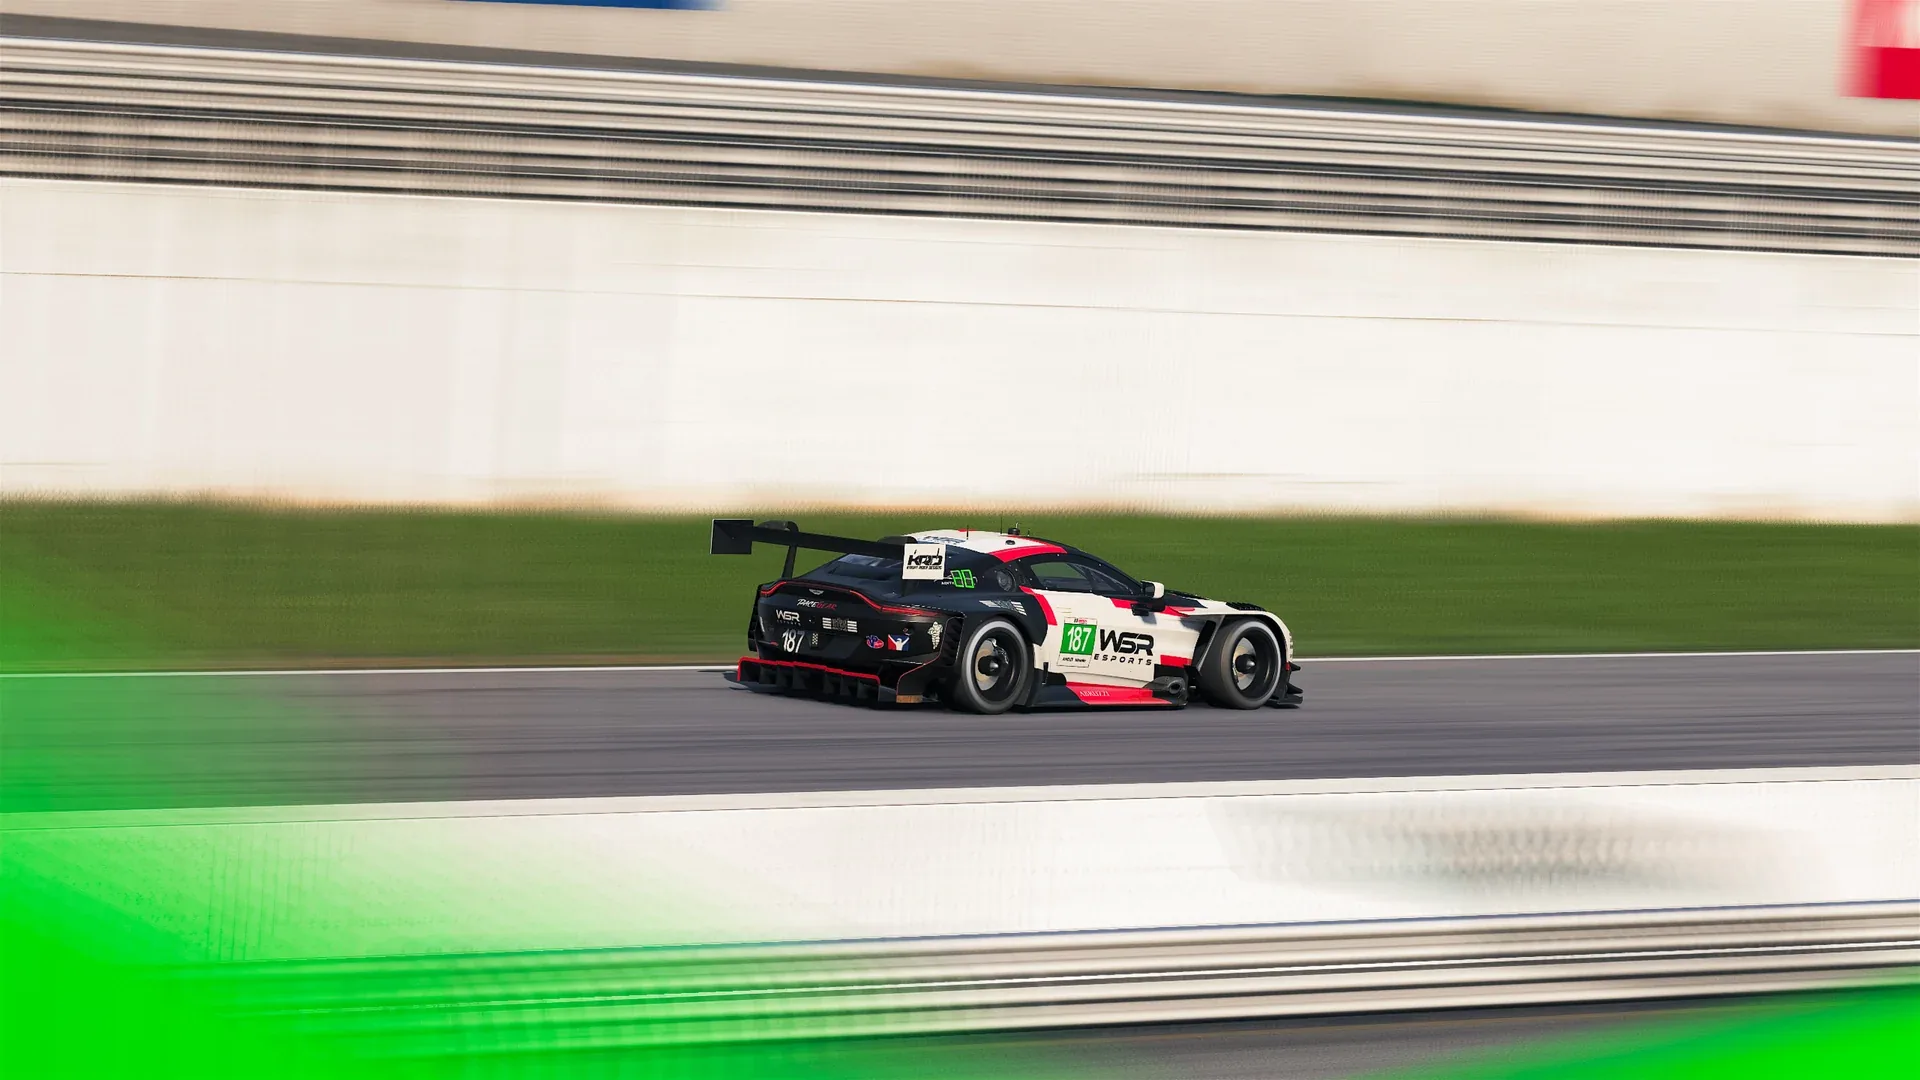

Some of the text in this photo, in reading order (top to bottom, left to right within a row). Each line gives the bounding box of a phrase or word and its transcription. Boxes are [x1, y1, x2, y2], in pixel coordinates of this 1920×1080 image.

[775, 609, 801, 622] WSR
[782, 628, 806, 653] 187
[1067, 625, 1092, 652] 187
[1099, 628, 1155, 656] WSR
[1093, 653, 1153, 666] ESPORTS
